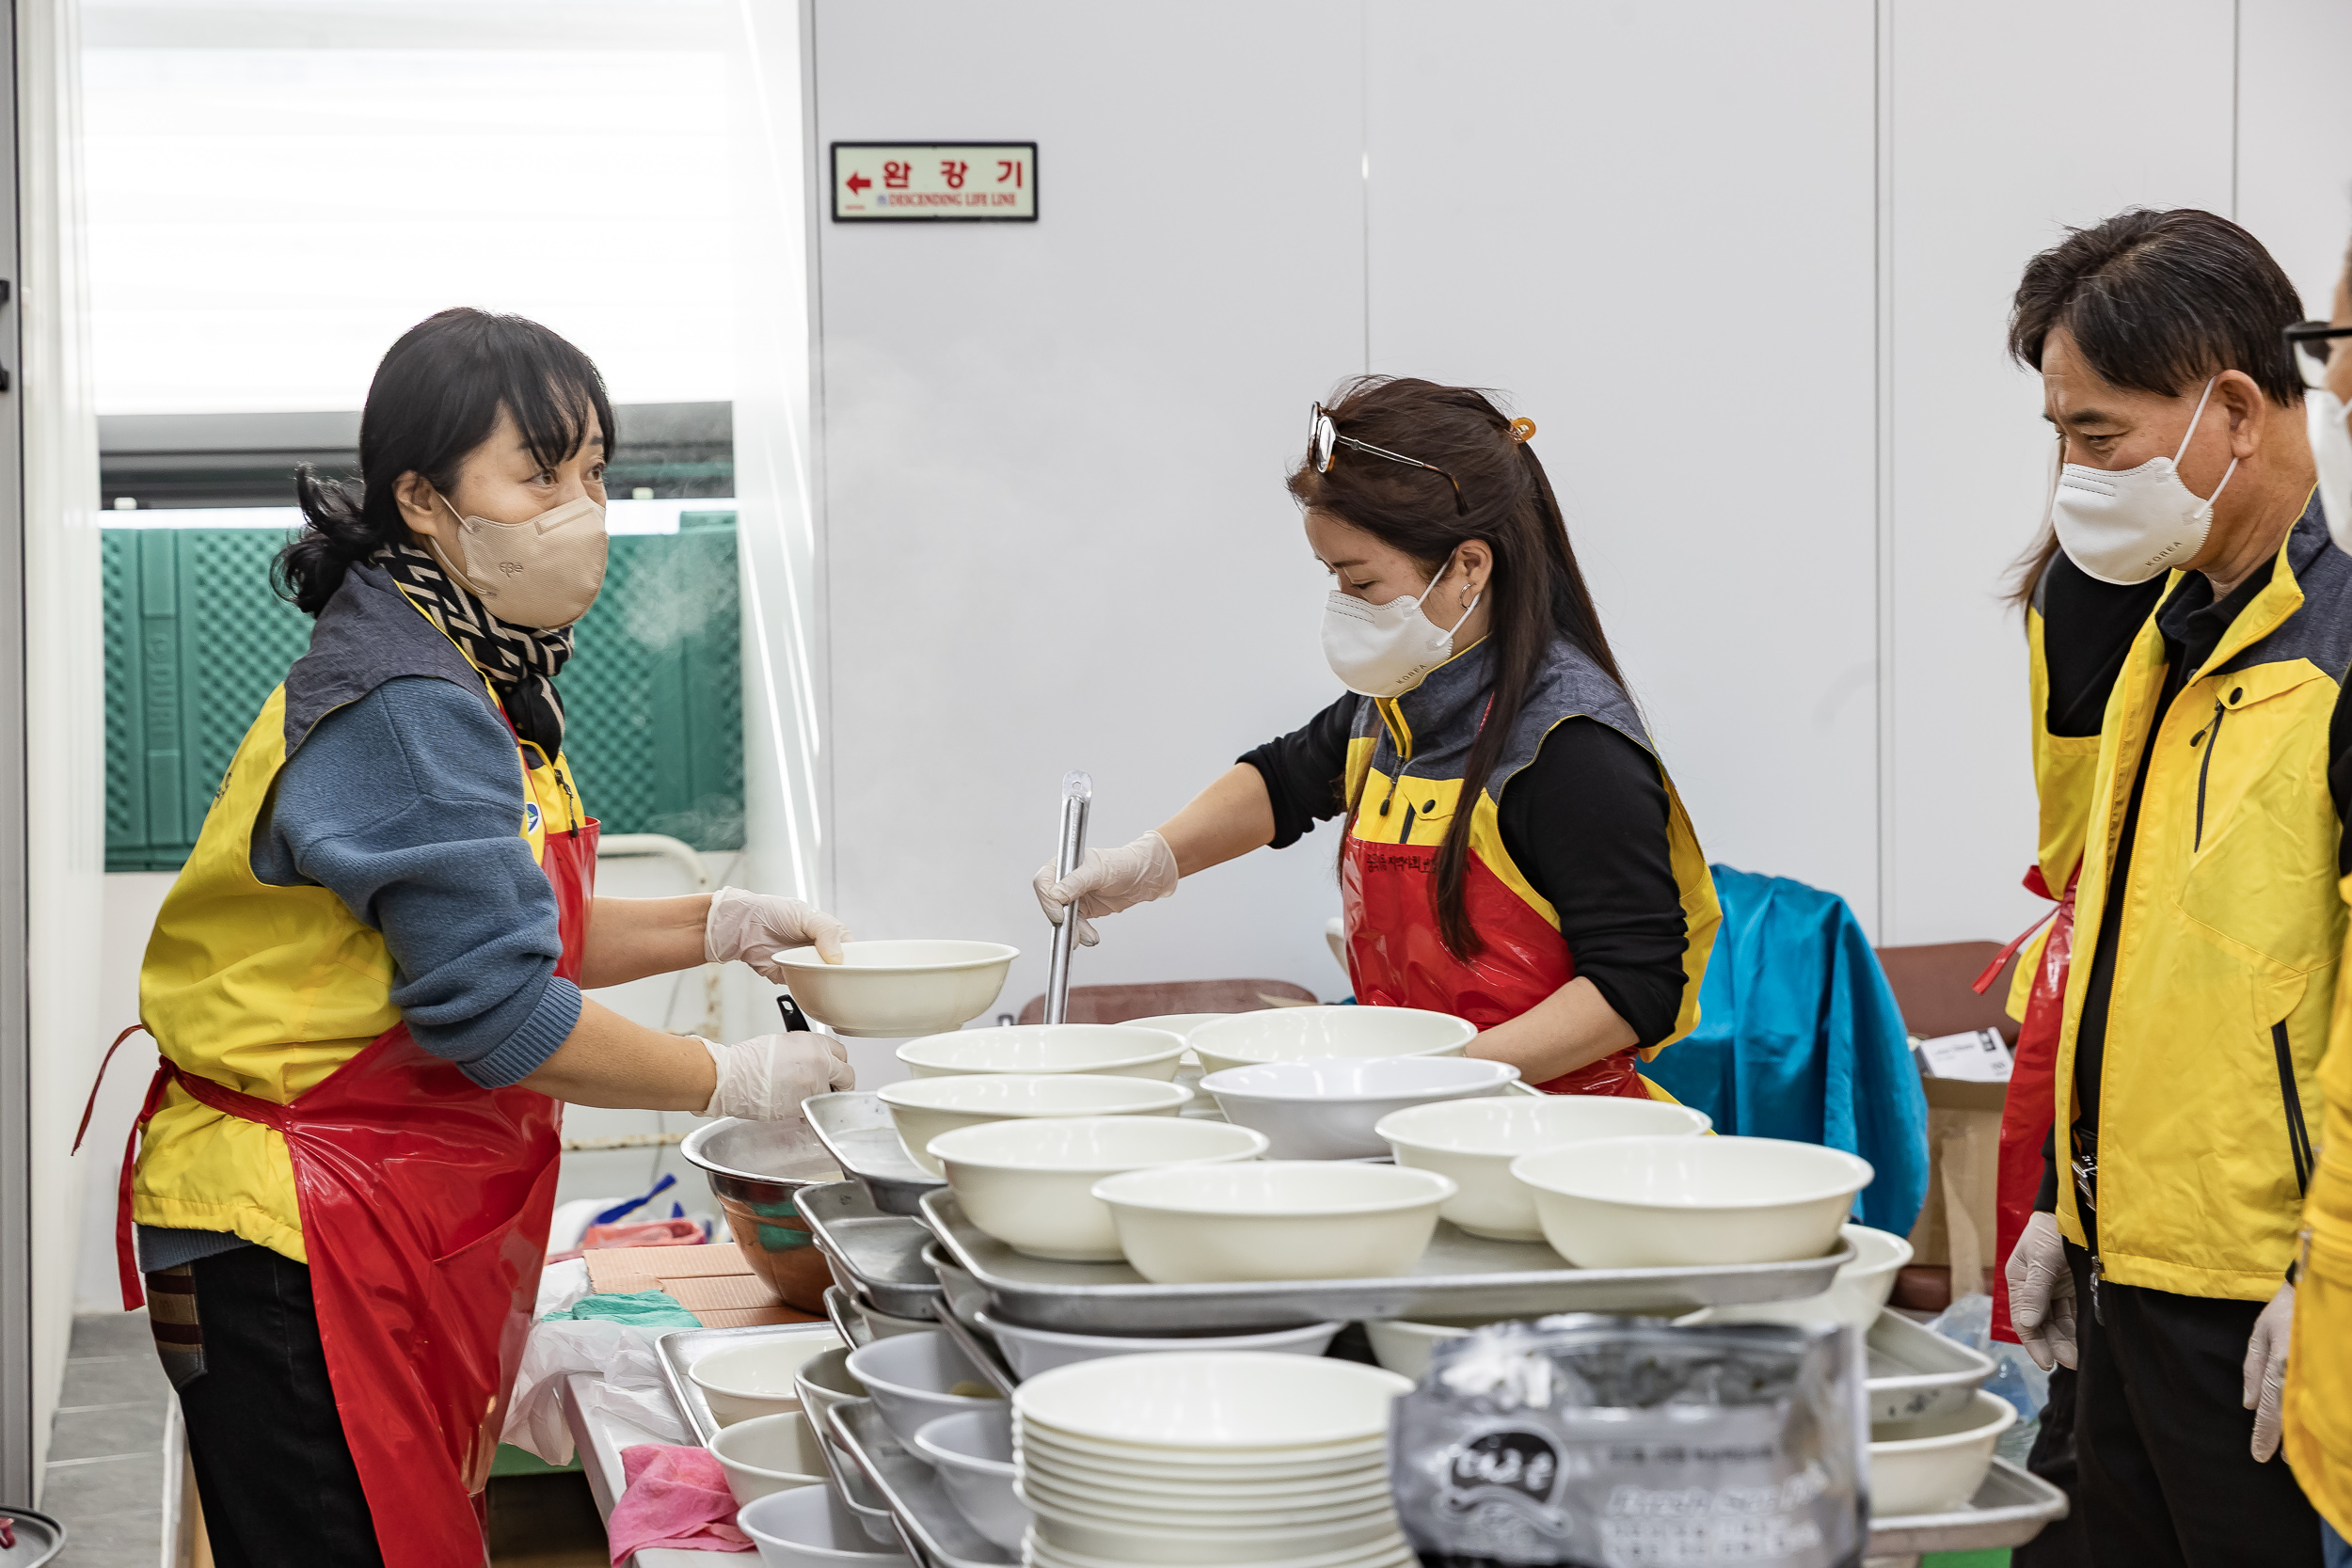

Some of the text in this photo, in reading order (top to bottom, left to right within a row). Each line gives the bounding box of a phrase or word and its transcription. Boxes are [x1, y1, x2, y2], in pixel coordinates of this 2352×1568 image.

[889, 193, 1016, 206] DESCENDING LIFE LINE
[2144, 540, 2183, 567] KOREA
[1395, 663, 1427, 685] KOREA
